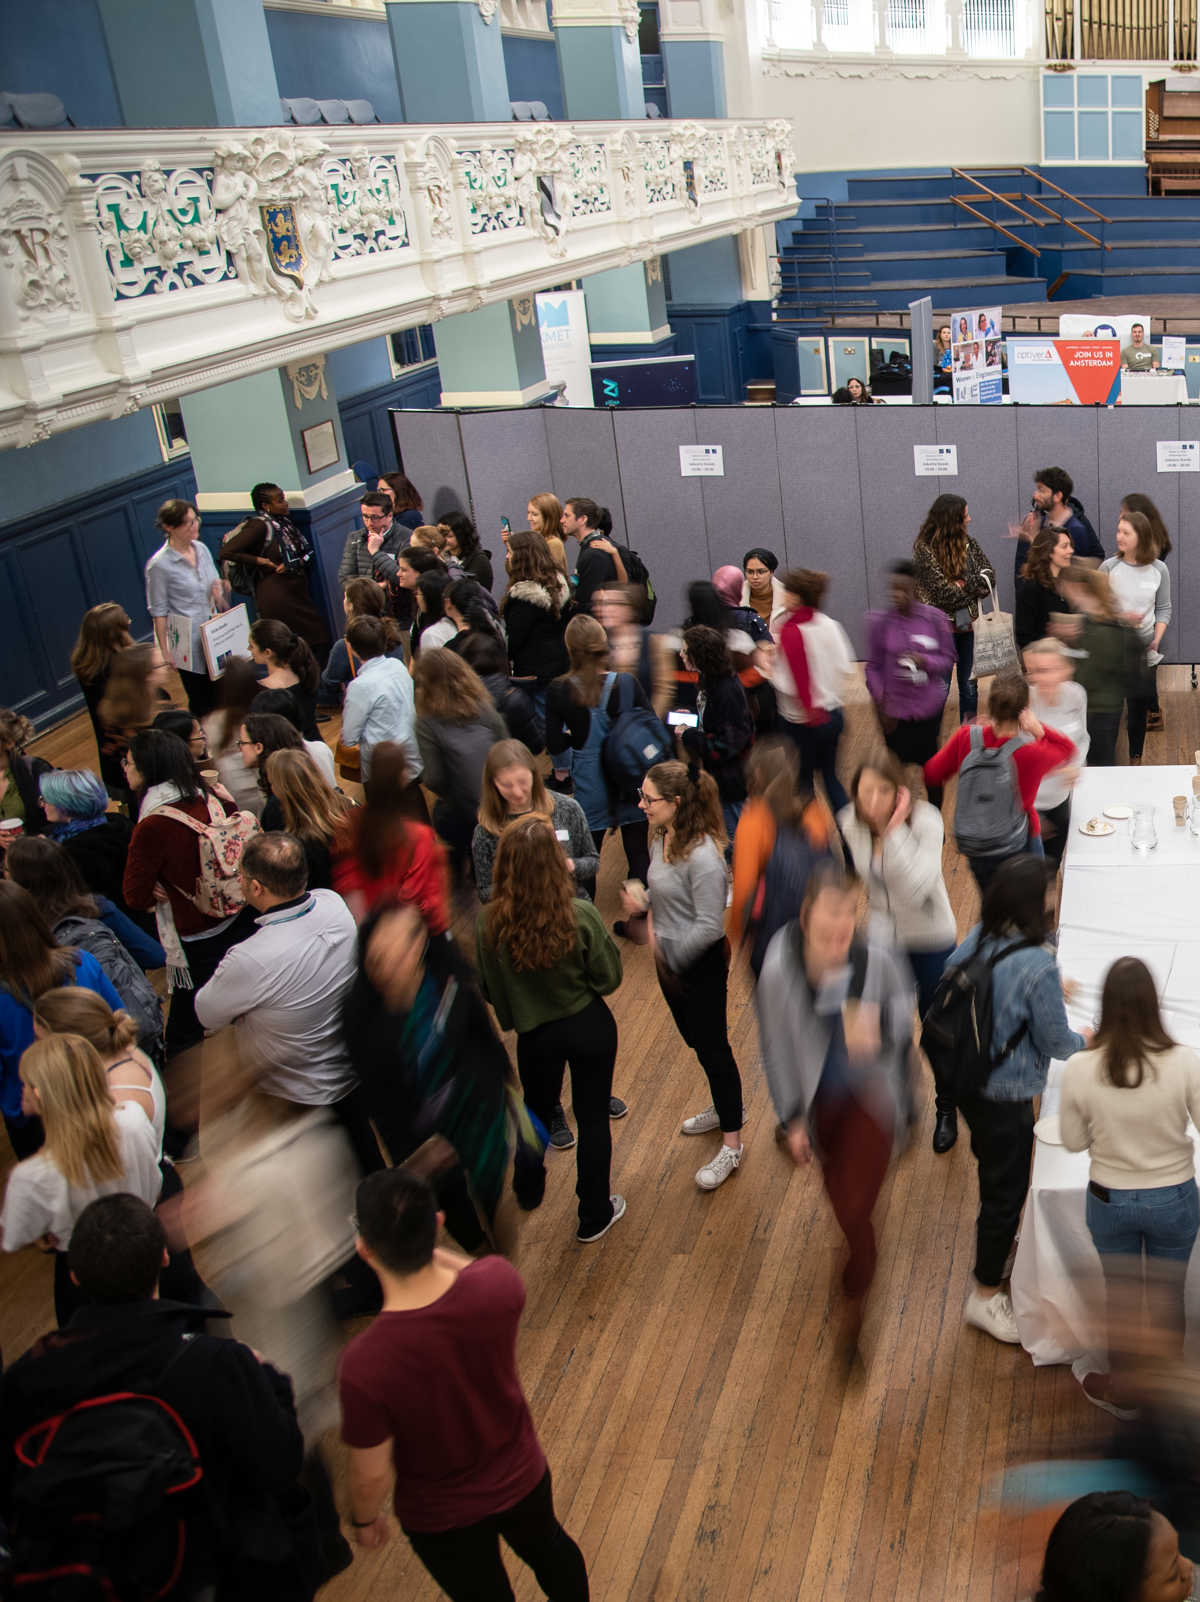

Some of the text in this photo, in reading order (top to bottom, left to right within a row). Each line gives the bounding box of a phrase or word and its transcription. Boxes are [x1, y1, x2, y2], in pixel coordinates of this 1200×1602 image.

[1074, 351, 1113, 359] JOIN US IN
